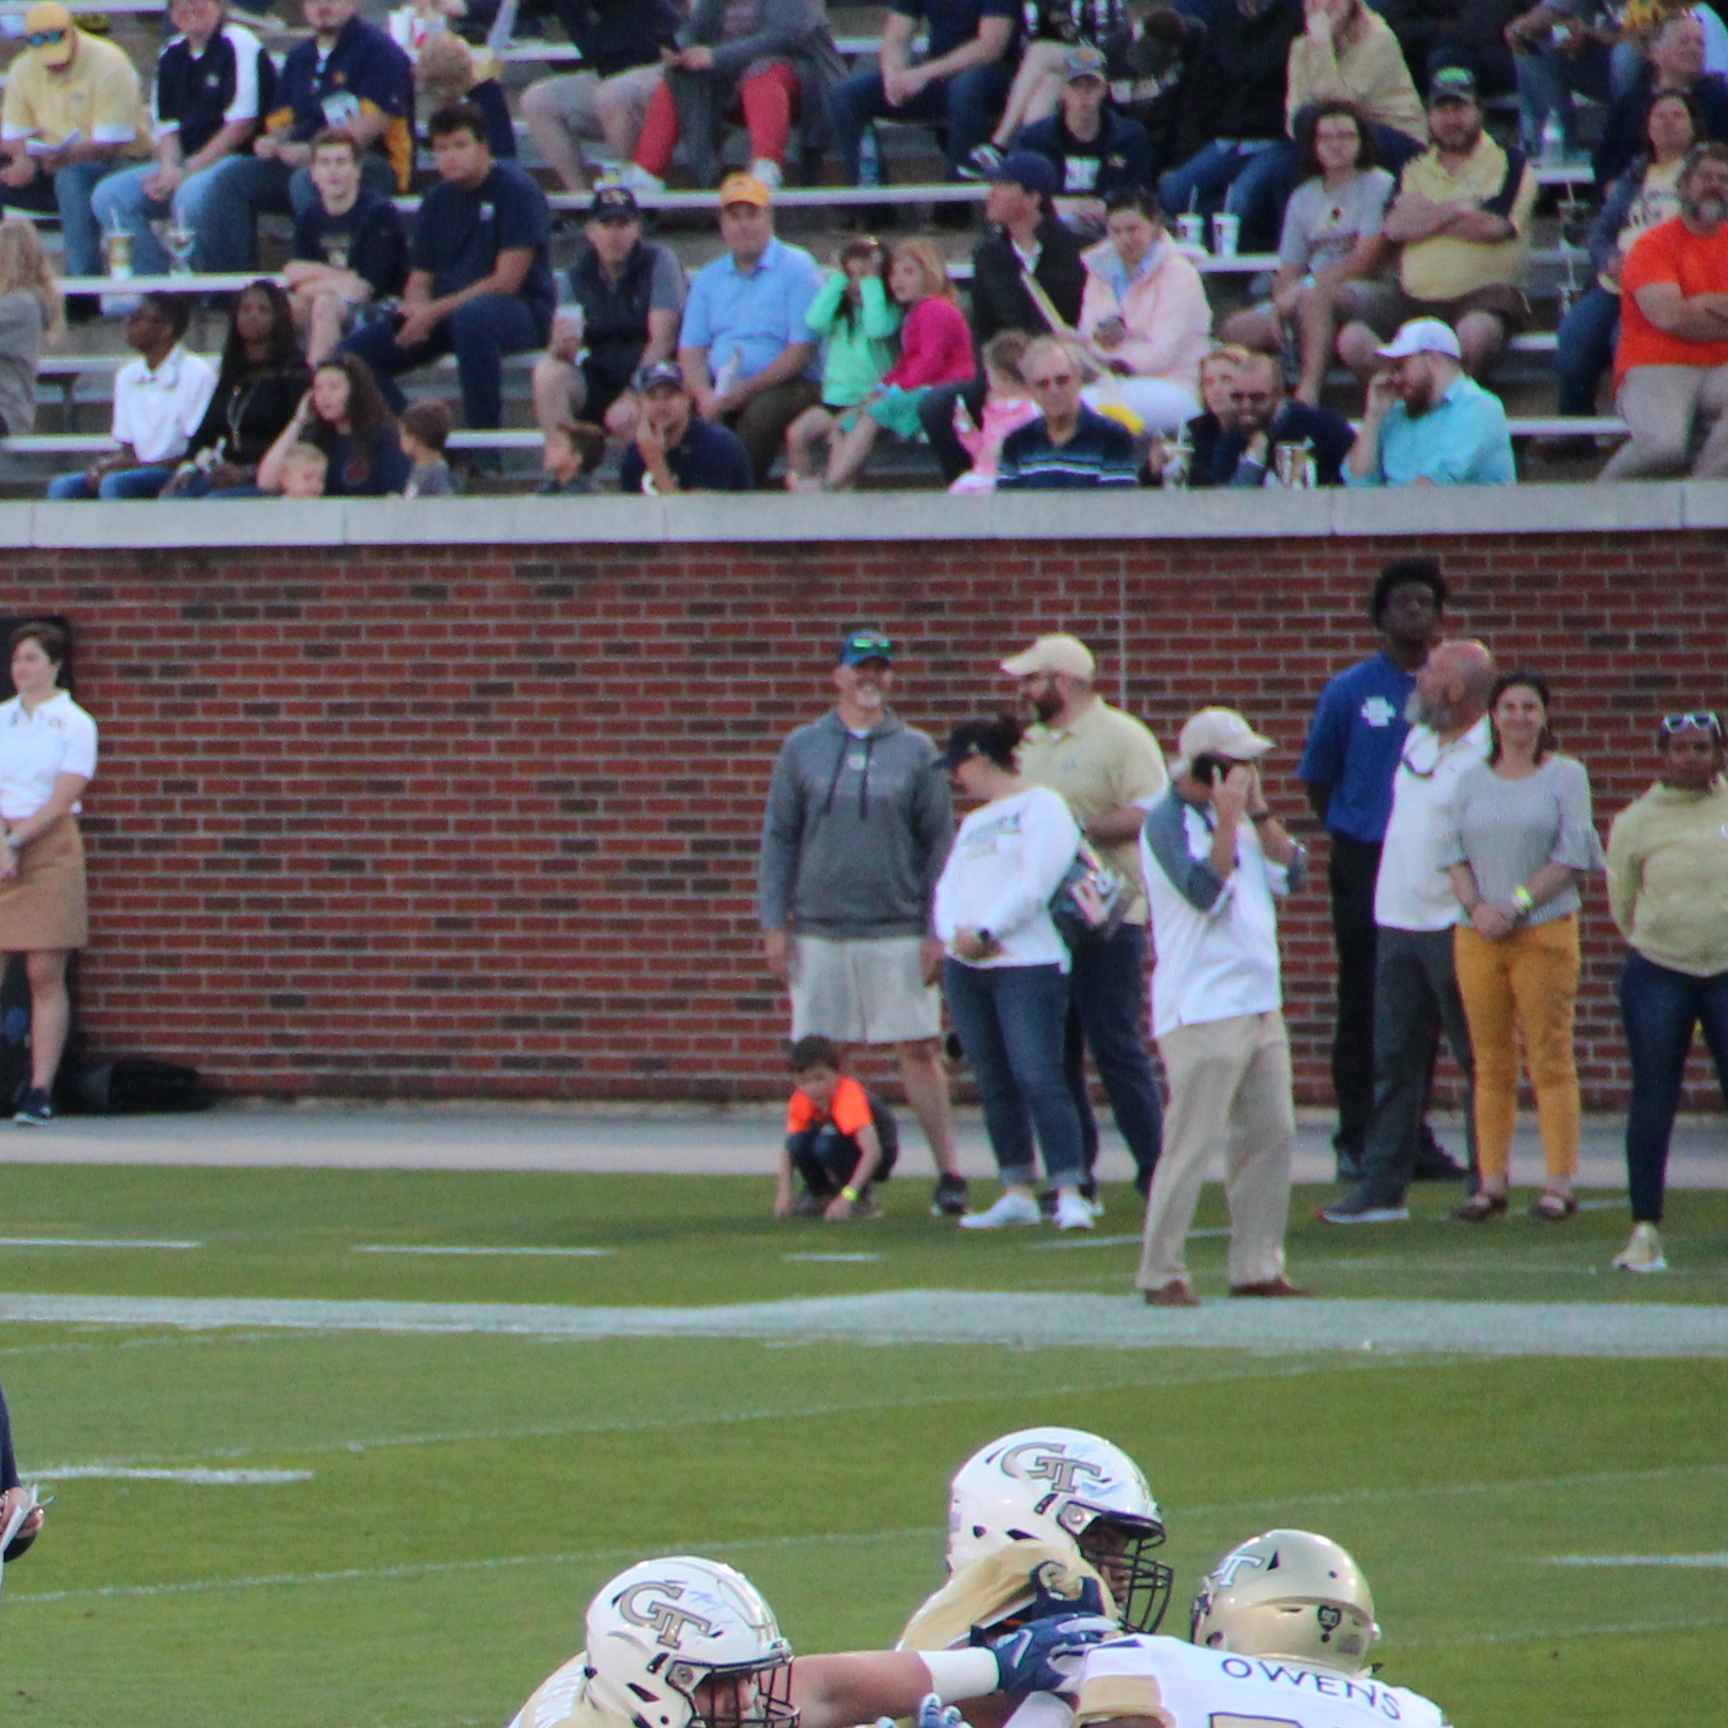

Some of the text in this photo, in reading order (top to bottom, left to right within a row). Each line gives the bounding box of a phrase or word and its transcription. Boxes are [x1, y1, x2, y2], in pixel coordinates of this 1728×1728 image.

[1000, 1441, 1102, 1494] GT
[620, 1580, 711, 1650] GT
[1221, 1657, 1402, 1720] OWENS
